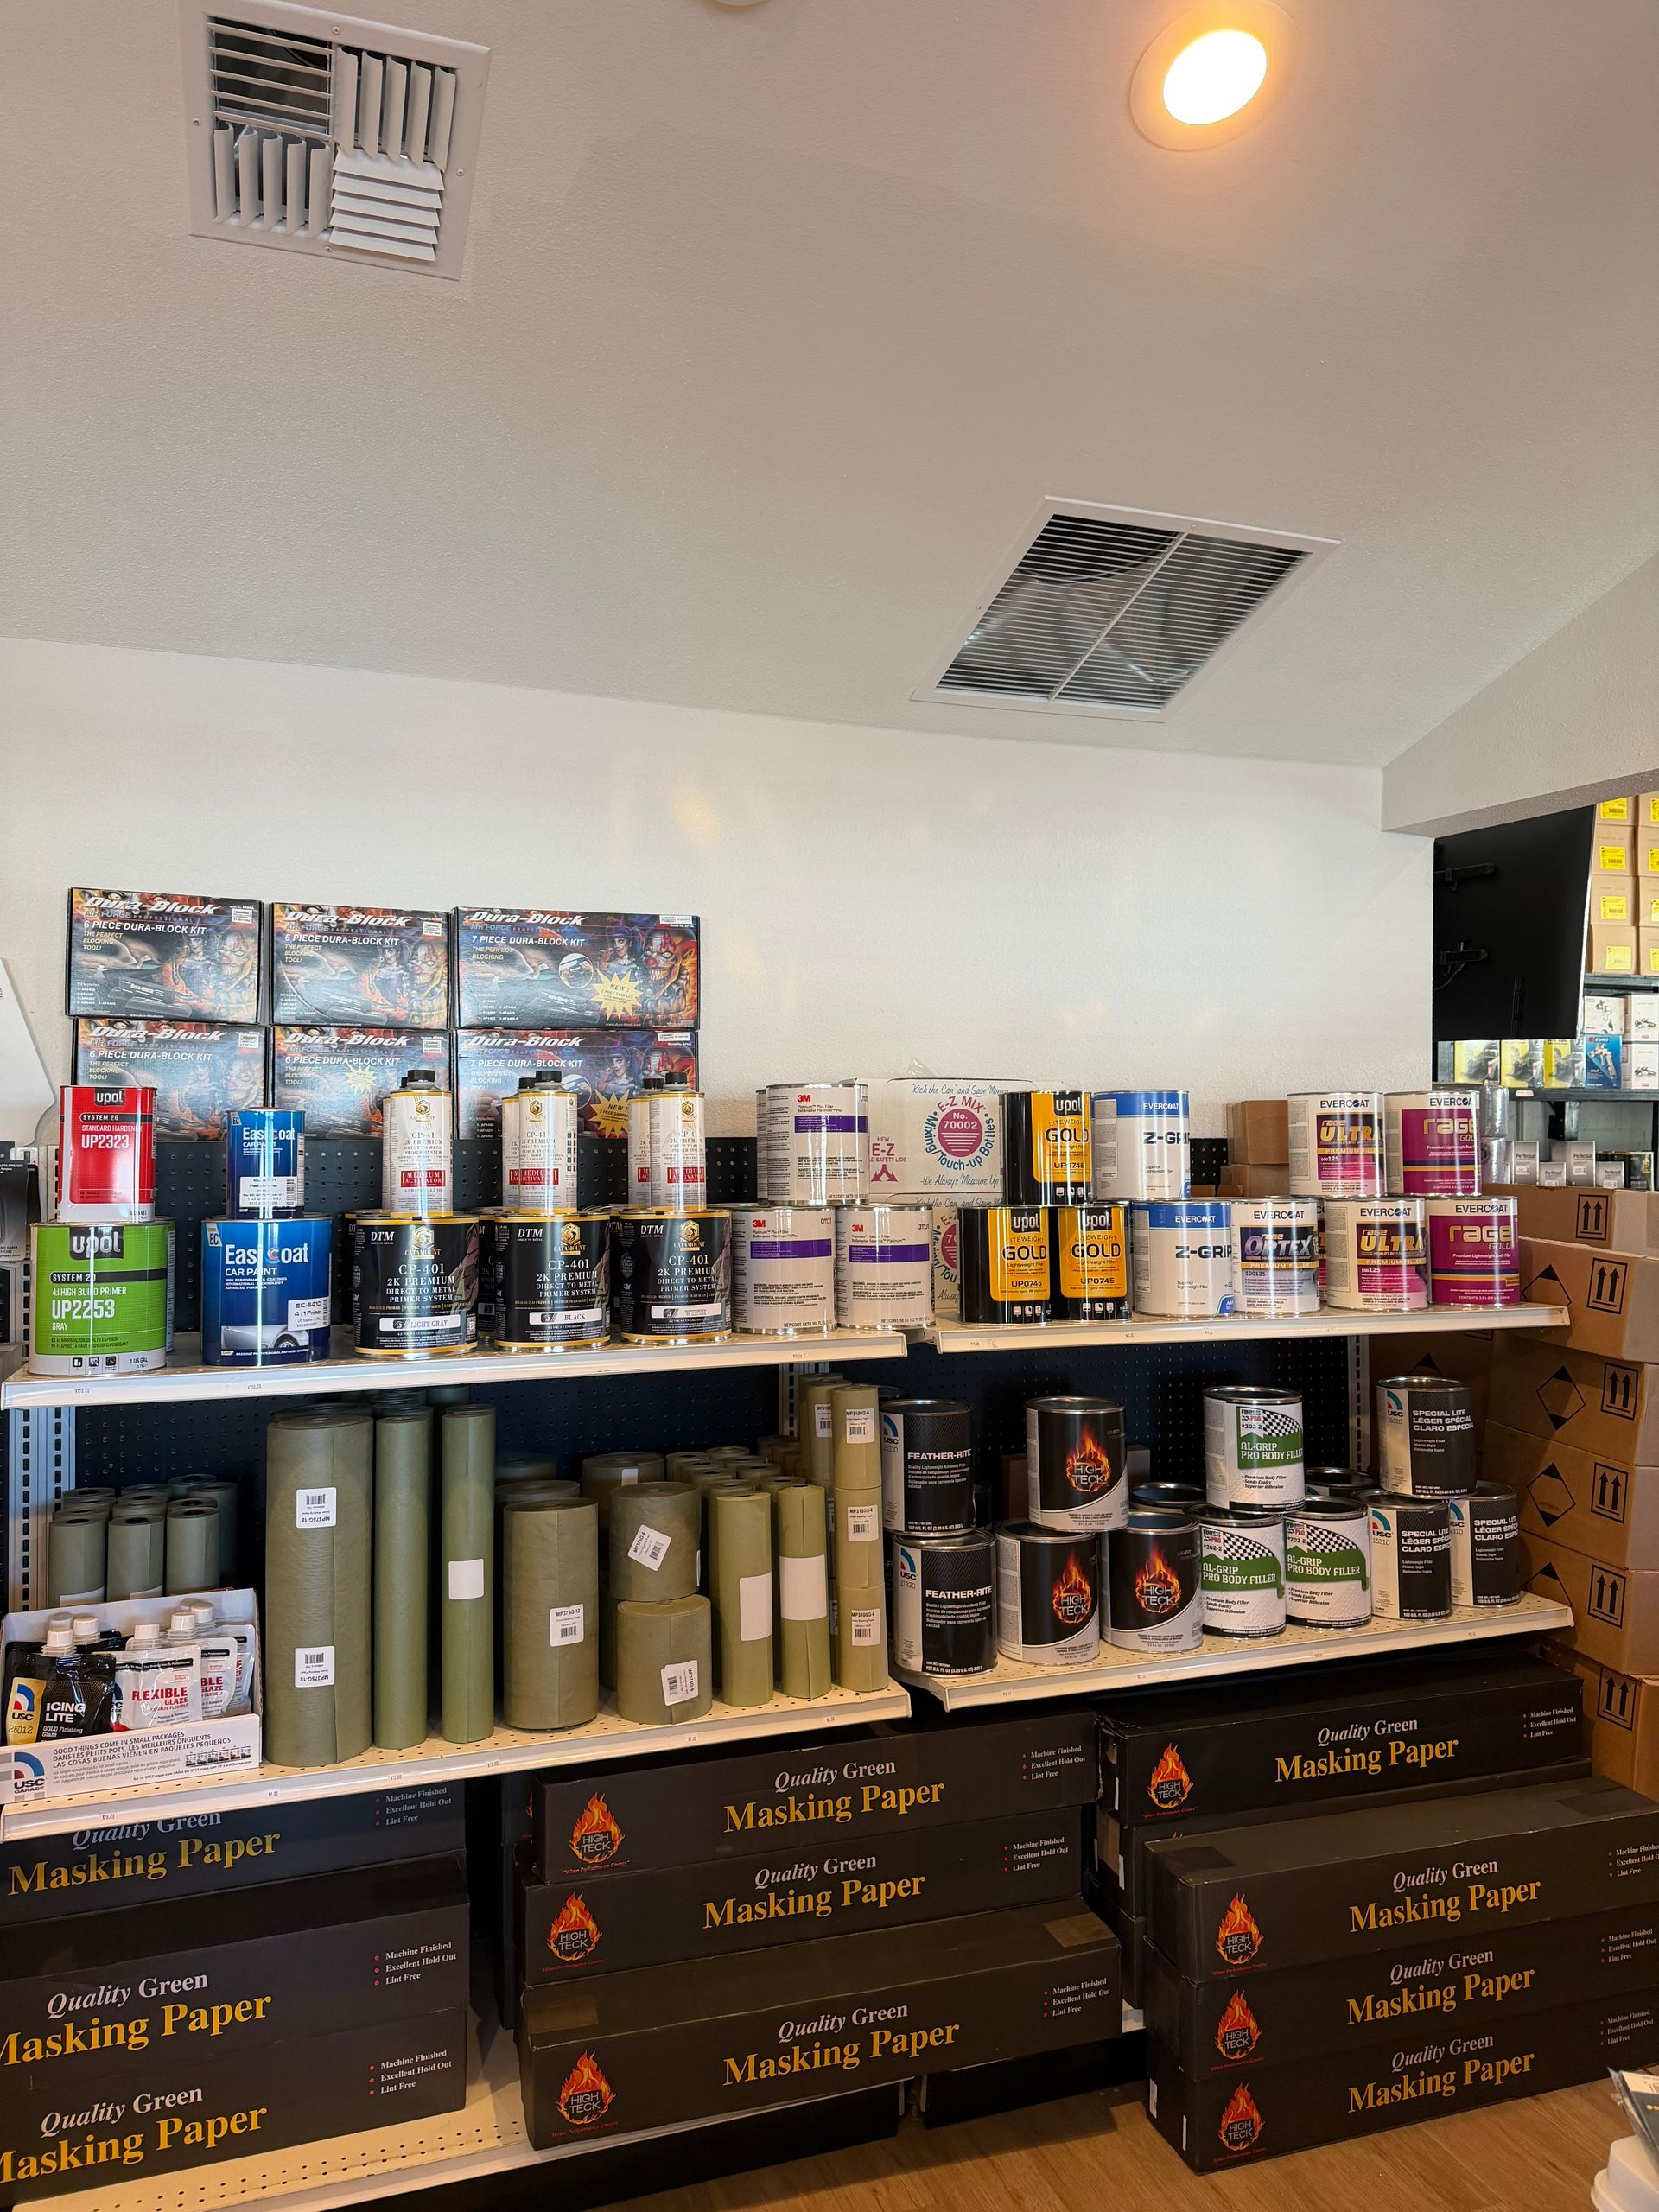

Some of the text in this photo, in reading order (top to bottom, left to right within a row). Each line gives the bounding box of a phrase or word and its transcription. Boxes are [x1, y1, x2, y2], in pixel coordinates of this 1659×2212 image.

[84, 896, 219, 915] Dura-Block
[470, 912, 588, 925] Dura-Block
[92, 921, 121, 931] PIECE
[123, 923, 188, 933] DURA-BLOCK
[190, 925, 207, 935] KIT
[510, 937, 568, 945] DURA-BLOCK
[97, 1091, 124, 1104] upol
[944, 1121, 977, 1129] 70002
[81, 1135, 129, 1149] UP2323
[872, 1143, 895, 1156] E-Z
[1254, 1211, 1304, 1219] EVERCOAT
[1456, 1205, 1508, 1213] EVERCOAT
[1013, 1213, 1039, 1232] upol
[210, 1234, 219, 1244] EC
[372, 1232, 394, 1241] DTM
[518, 1229, 543, 1238] DTM
[73, 1235, 121, 1253] upol
[1071, 1243, 1121, 1258] GOLD
[1002, 1245, 1046, 1260] GOLD
[399, 1263, 444, 1274] CP-401
[405, 1276, 454, 1285] PREMIUM
[52, 1299, 115, 1319] UP2253
[1241, 1442, 1277, 1451] AL-GRIP
[907, 1448, 972, 1460] FEATHER-RITE
[1241, 1451, 1284, 1459] PRO BODY
[1074, 1465, 1103, 1475] HIGH
[1072, 1475, 1105, 1484] TECK
[1287, 1555, 1322, 1567] AL-GRIP
[1203, 1562, 1238, 1574] AL-GRIP
[1287, 1566, 1360, 1576] PRO BODY FILLER
[1203, 1573, 1275, 1584] PRO BODY FILLER
[925, 1585, 993, 1599] FEATHER-RITE
[1143, 1586, 1173, 1596] HIGH
[1142, 1595, 1174, 1605] TECK
[131, 1687, 188, 1701] FLEXIBLE
[46, 1702, 86, 1713] ICING
[164, 1697, 188, 1706] GLAZE
[12, 1712, 34, 1721] USC
[46, 1713, 73, 1723] LITE
[130, 1737, 150, 1745] SMALL
[152, 1732, 185, 1743] PACKAGES
[1317, 1717, 1419, 1748] Quality Green
[86, 1747, 107, 1757] PETITS
[1274, 1736, 1459, 1783] Masking Paper
[774, 1758, 898, 1793] Quality Green
[14, 1778, 46, 1789] USC
[15, 1785, 45, 1794] GARAGE
[723, 1779, 945, 1834] Masking Paper
[582, 1833, 610, 1845] HIGH
[581, 1839, 612, 1853] TECK
[8, 1832, 281, 1896] Masking Paper
[754, 1853, 878, 1890] Quality Green
[1392, 1859, 1498, 1891] Quality Green
[703, 1872, 926, 1930] Masking Paper
[1350, 1878, 1541, 1934] Masking Paper
[385, 1941, 452, 1961] Machine Finished
[385, 1952, 457, 1974] Excellent Hold Out
[1389, 1948, 1494, 1985] Quality Green
[385, 1972, 421, 1985] Lint Free
[48, 1973, 209, 2020] Quality Green
[1346, 1968, 1535, 2025] Masking Paper
[161, 1994, 273, 2037] Paper
[778, 2003, 909, 2043] Quality Green
[722, 2021, 961, 2087] Masking Paper
[1391, 2034, 1495, 2072] Quality Green
[1348, 2050, 1535, 2114] Masking Paper
[41, 2087, 203, 2139] Quality Green
[156, 2106, 268, 2152] Paper
